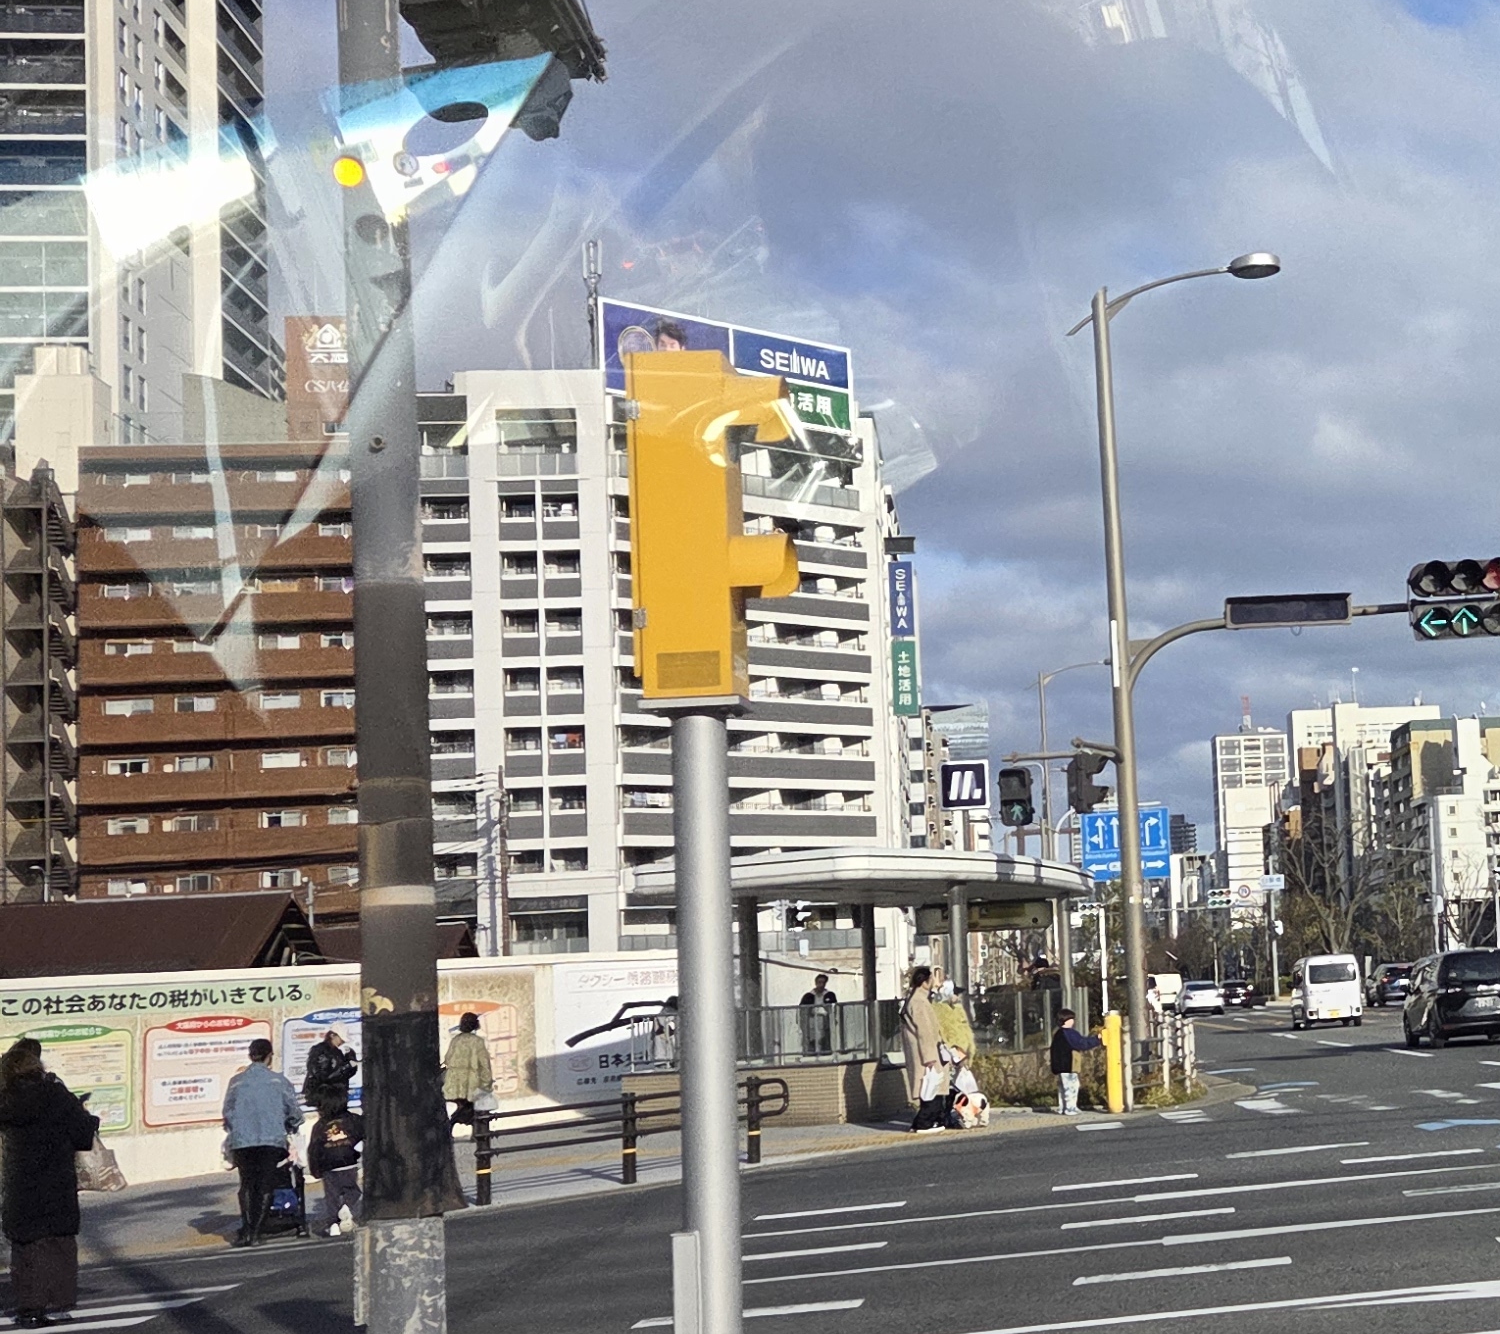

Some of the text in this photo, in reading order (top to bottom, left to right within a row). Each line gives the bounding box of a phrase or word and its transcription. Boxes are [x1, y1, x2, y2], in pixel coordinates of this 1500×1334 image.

[897, 651, 912, 706] 土地活用
[1, 984, 311, 1017] この社会あなたの税がいきている。
